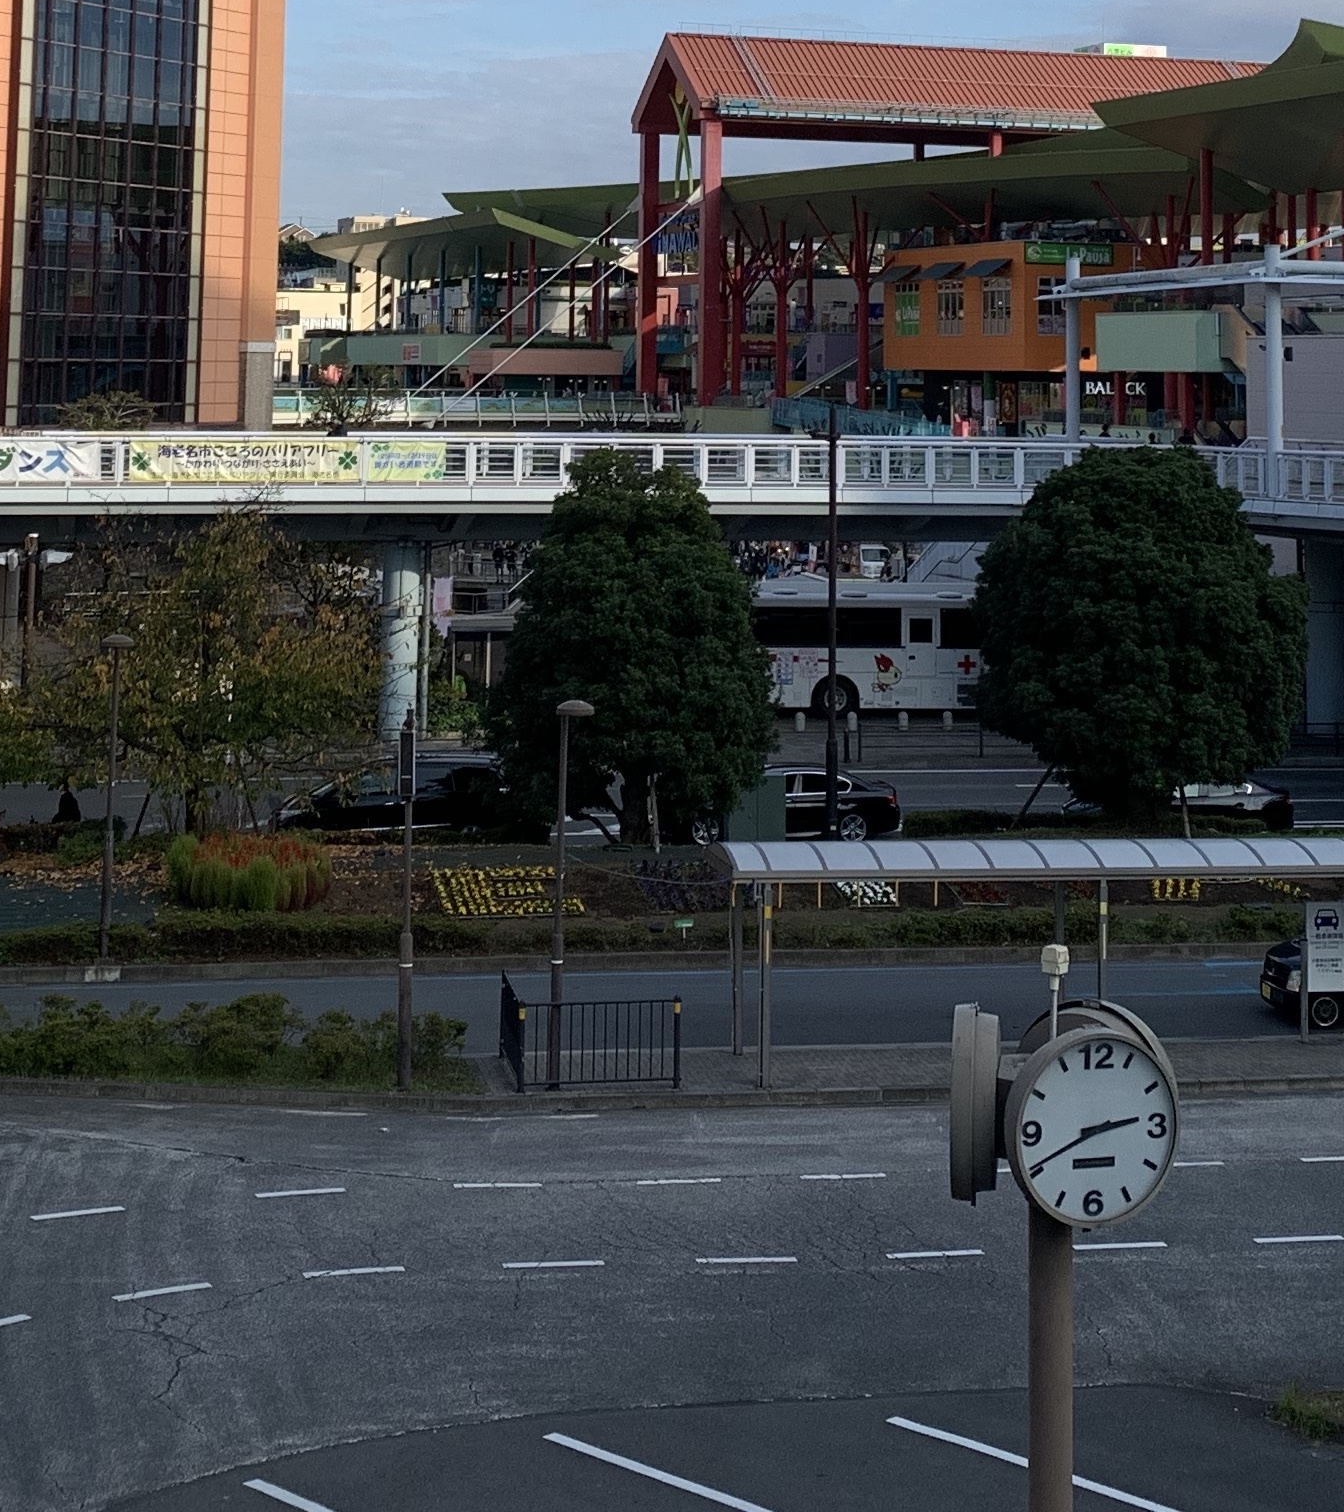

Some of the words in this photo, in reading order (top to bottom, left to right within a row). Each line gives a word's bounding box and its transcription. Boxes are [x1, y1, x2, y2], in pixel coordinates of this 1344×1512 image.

[157, 444, 340, 459] 海老名市こころのバリアフリー
[1078, 1043, 1115, 1070] 12
[1022, 1120, 1043, 1147] 9
[1147, 1112, 1168, 1139] 3
[1082, 1190, 1104, 1217] 6
